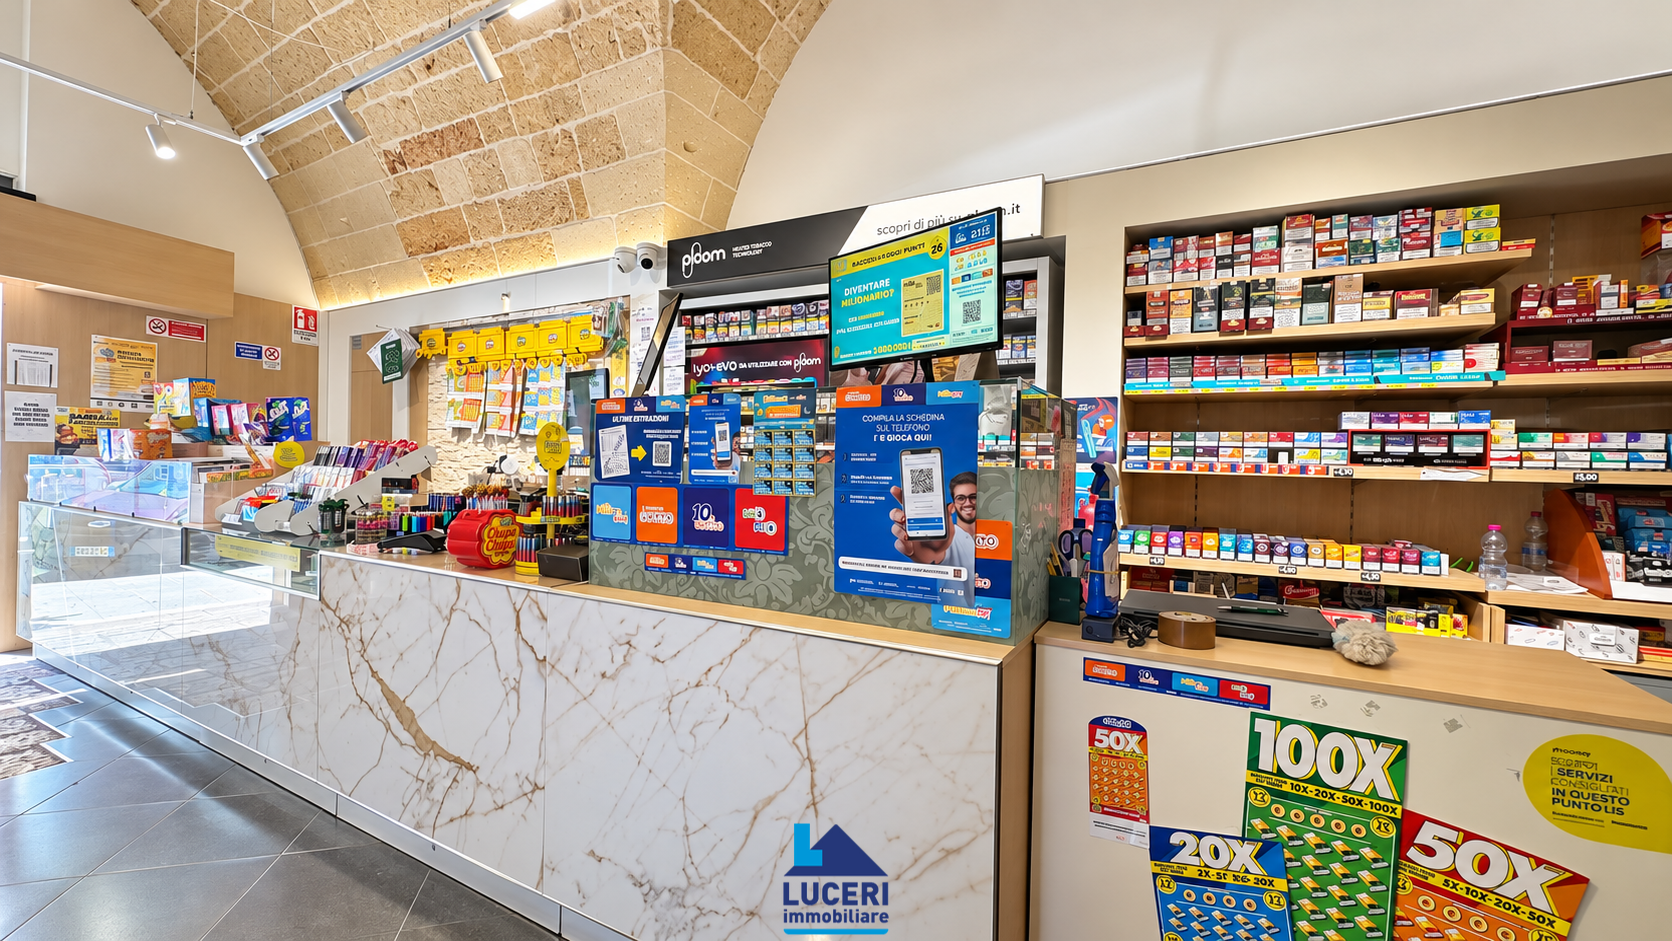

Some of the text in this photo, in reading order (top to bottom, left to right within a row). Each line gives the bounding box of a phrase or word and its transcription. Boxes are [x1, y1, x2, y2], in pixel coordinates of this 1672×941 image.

[876, 220, 911, 236] scopri
[914, 218, 924, 230] di
[931, 242, 943, 255] 26
[682, 242, 726, 278] ploom
[844, 278, 890, 296] DIVENTARE
[794, 352, 821, 372] ploom
[906, 413, 945, 422] SCHEDINA
[887, 434, 913, 442] GIOCA
[914, 434, 932, 442] QUI!
[1094, 728, 1141, 752] 50X
[1253, 718, 1400, 802] 100X
[1557, 768, 1613, 784] SERVIZI
[1552, 788, 1630, 806] IN QUESTO
[1552, 798, 1625, 816] PUNTO LIS
[1169, 830, 1264, 876] 20X
[1406, 820, 1570, 916] 50X
[1442, 878, 1557, 930] 5X-10X-20X-50X
